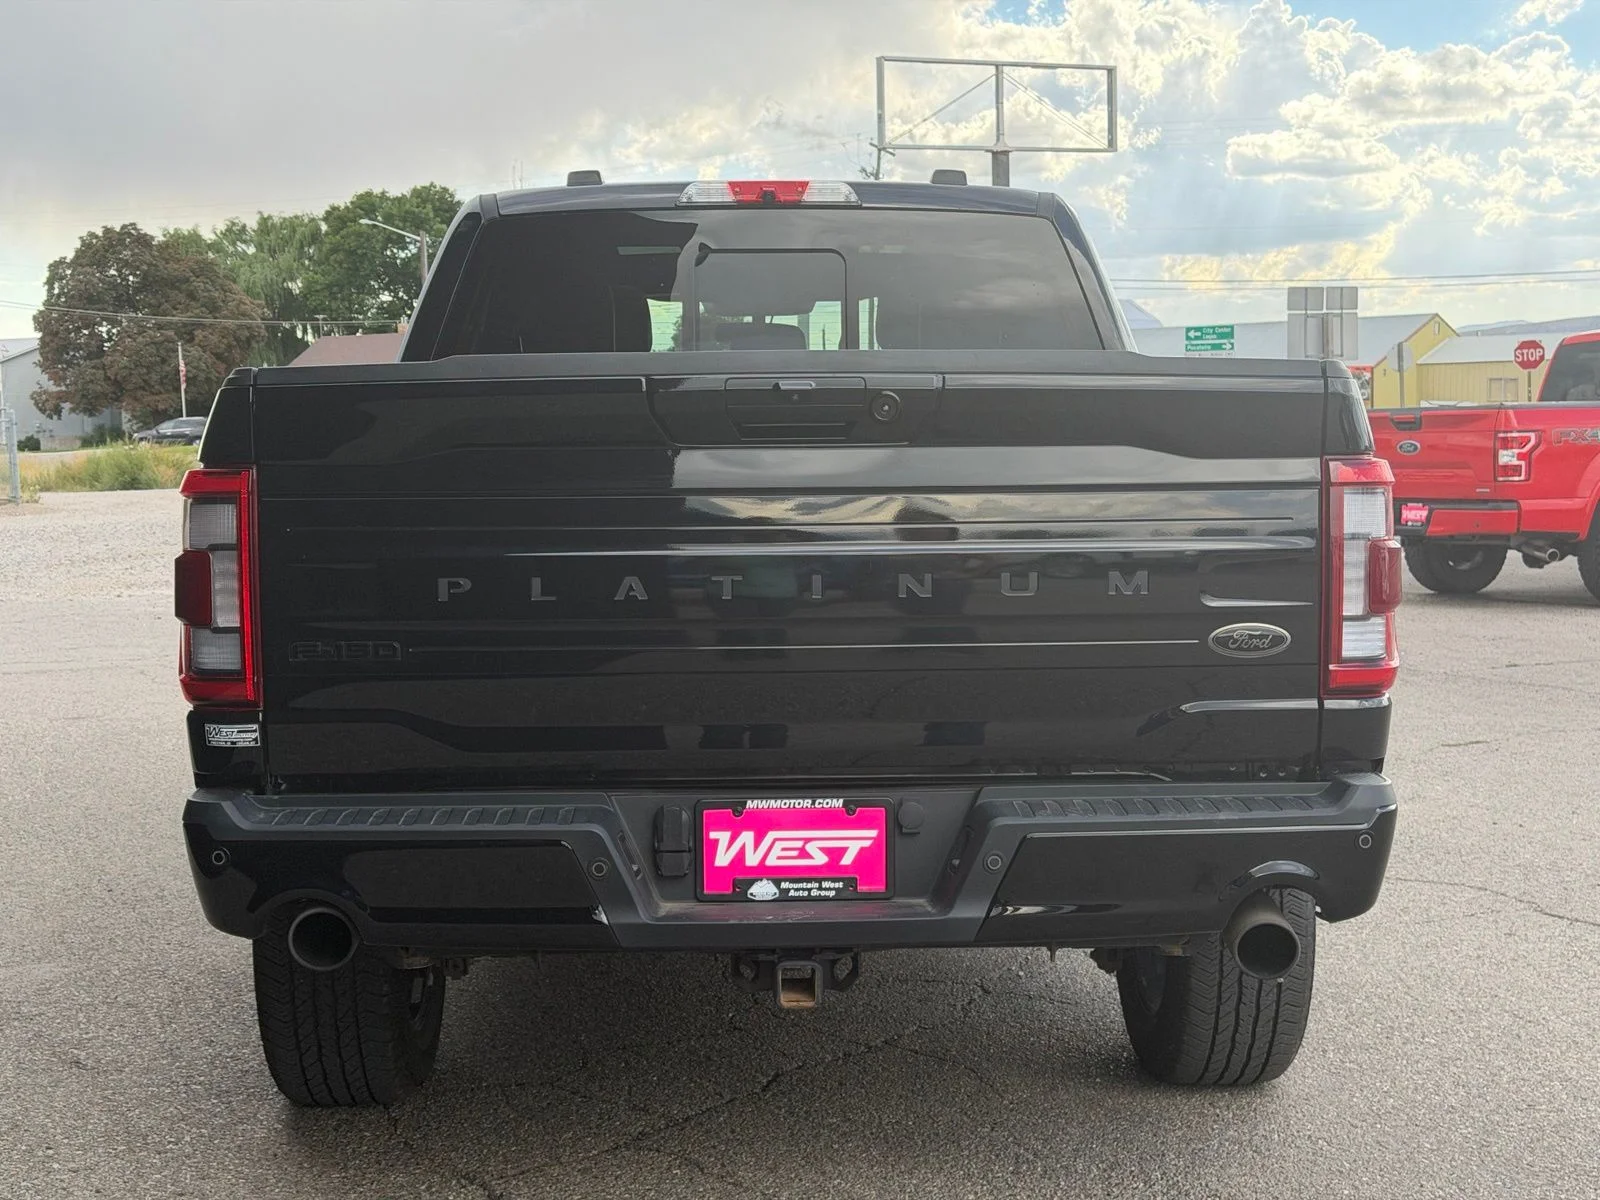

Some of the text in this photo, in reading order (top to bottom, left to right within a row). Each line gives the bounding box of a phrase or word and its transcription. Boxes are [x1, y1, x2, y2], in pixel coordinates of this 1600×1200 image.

[1515, 348, 1544, 362] STOP
[437, 571, 1149, 602] PLATINUM
[1228, 629, 1274, 650] Ford
[746, 798, 844, 810] MWMOTOR.COM
[780, 880, 844, 890] Mountain West
[788, 889, 836, 898] Auto Group
